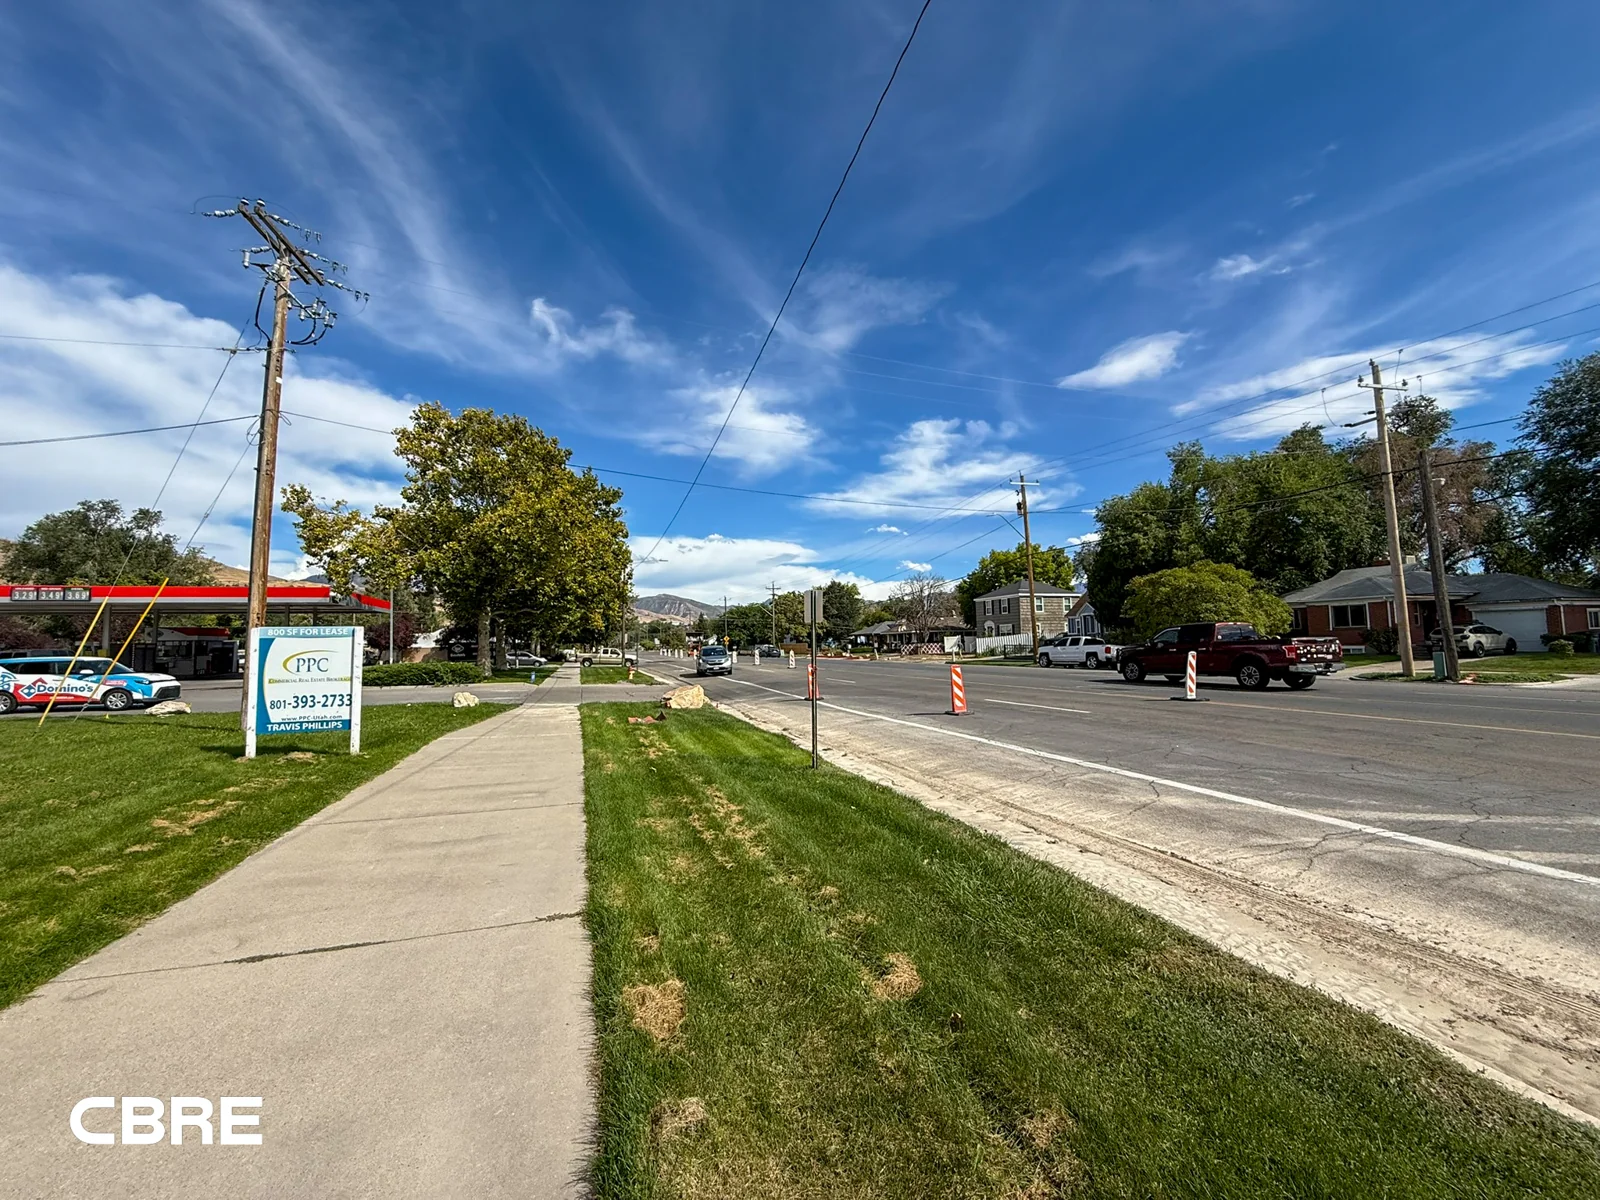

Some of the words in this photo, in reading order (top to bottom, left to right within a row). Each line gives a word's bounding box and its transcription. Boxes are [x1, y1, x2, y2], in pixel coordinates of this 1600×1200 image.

[296, 658, 329, 673] PPC
[37, 684, 94, 693] Domino's
[269, 694, 352, 709] 801-393-2733
[266, 722, 301, 732] TRAVIS
[302, 721, 343, 730] PHILLIPS
